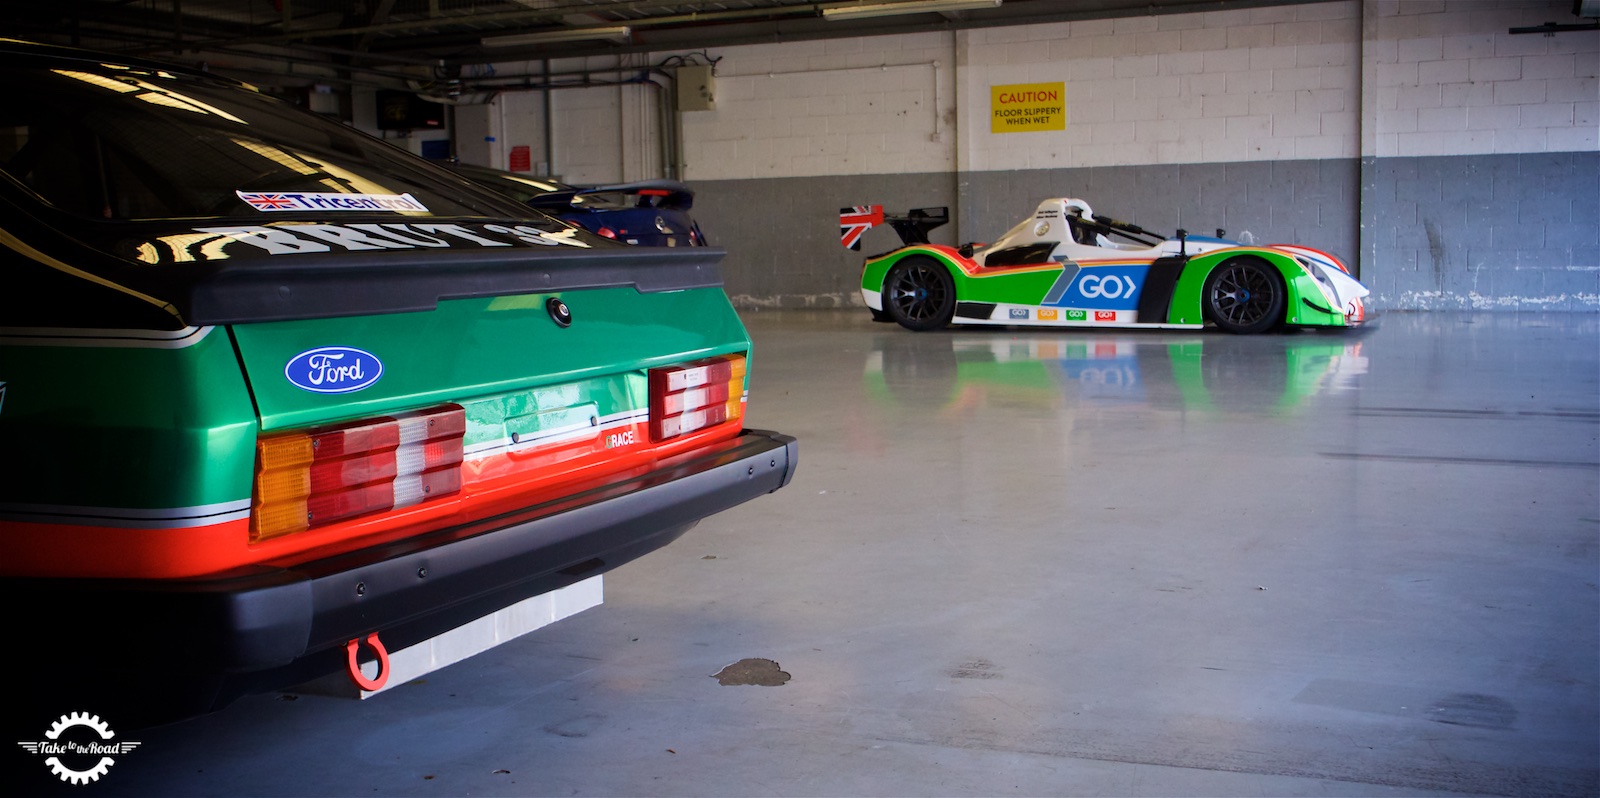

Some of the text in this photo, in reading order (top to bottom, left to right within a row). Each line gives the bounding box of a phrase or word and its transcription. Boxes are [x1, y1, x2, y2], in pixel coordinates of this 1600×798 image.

[999, 91, 1057, 104] CAUTION
[995, 107, 1061, 117] FLOOR SLIPPERY
[1033, 116, 1050, 124] WET
[191, 222, 514, 255] BRUT
[308, 353, 365, 385] Ford
